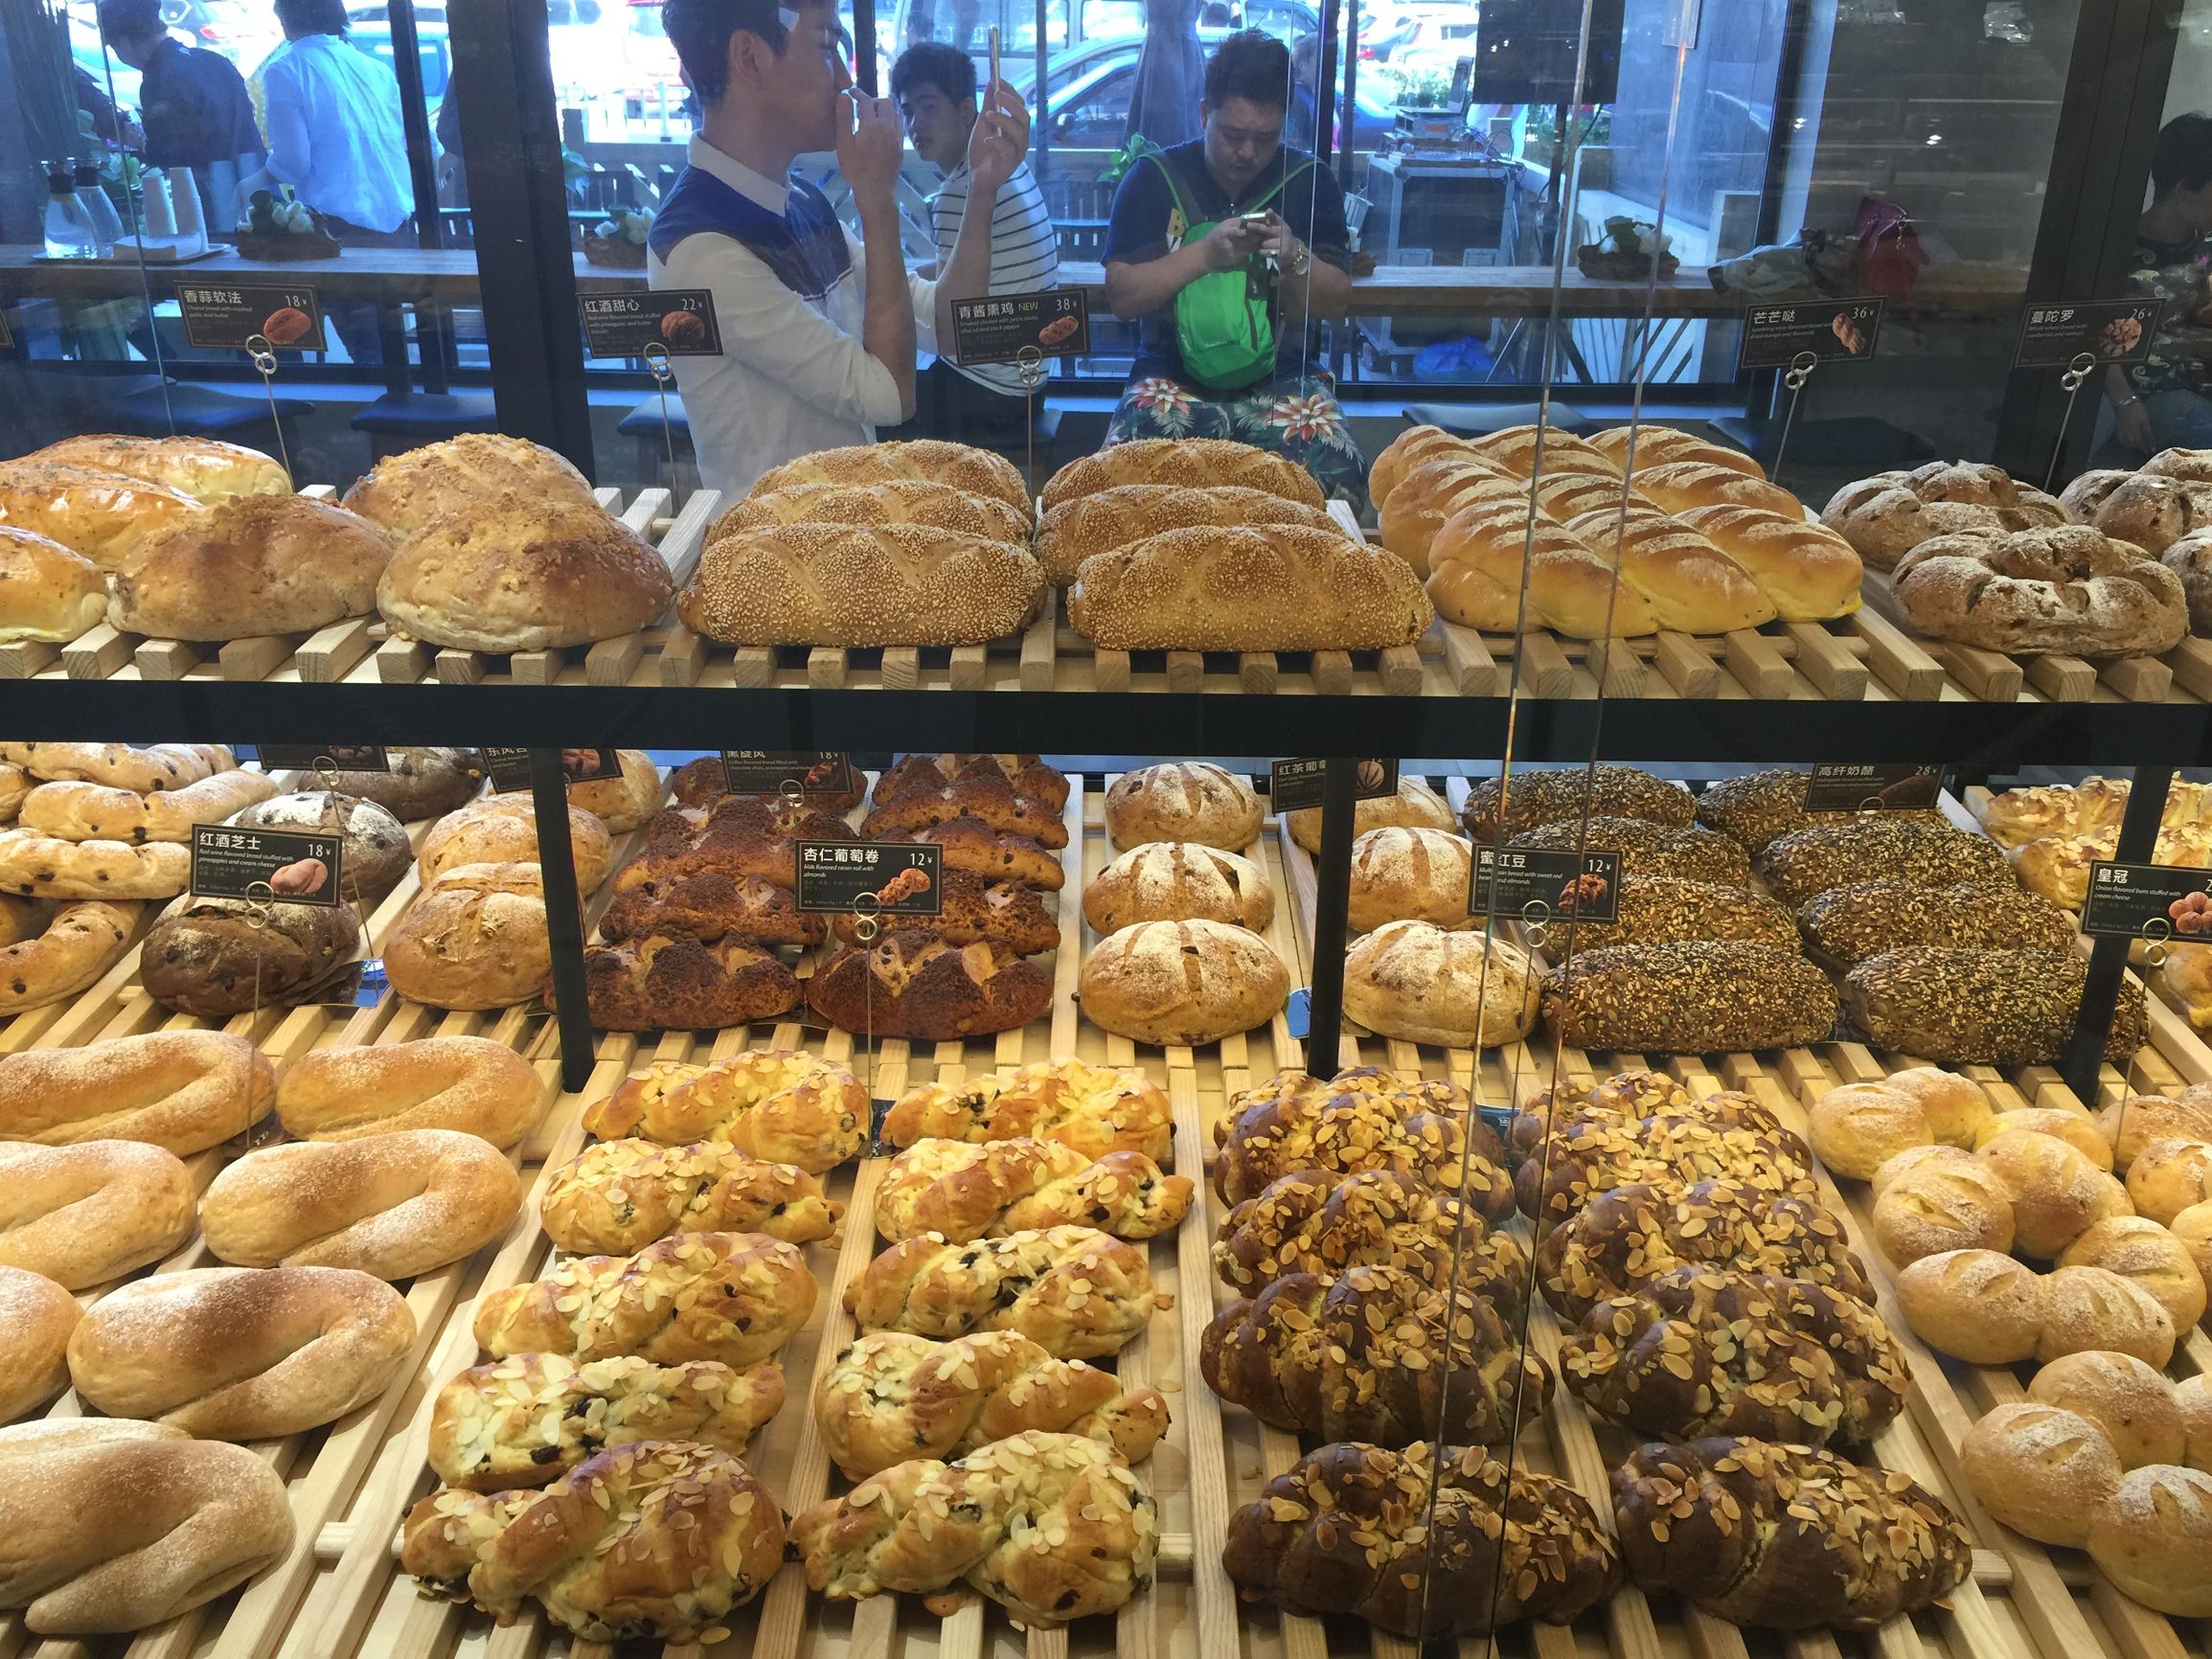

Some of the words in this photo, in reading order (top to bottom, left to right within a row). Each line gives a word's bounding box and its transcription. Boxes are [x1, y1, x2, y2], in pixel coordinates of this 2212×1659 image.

[184, 290, 242, 305] 香蒜软法
[584, 298, 640, 313] 红酒甜心
[1018, 302, 1038, 312] NEW
[1753, 308, 1796, 325] 芒芒哒
[1818, 765, 1875, 777] 高纤奶酪
[199, 831, 262, 851] 红酒芝士
[223, 850, 245, 858] flavored
[804, 848, 879, 864] 杏仁葡萄卷
[2097, 868, 2129, 885] 皇冠
[2112, 885, 2136, 894] flavored
